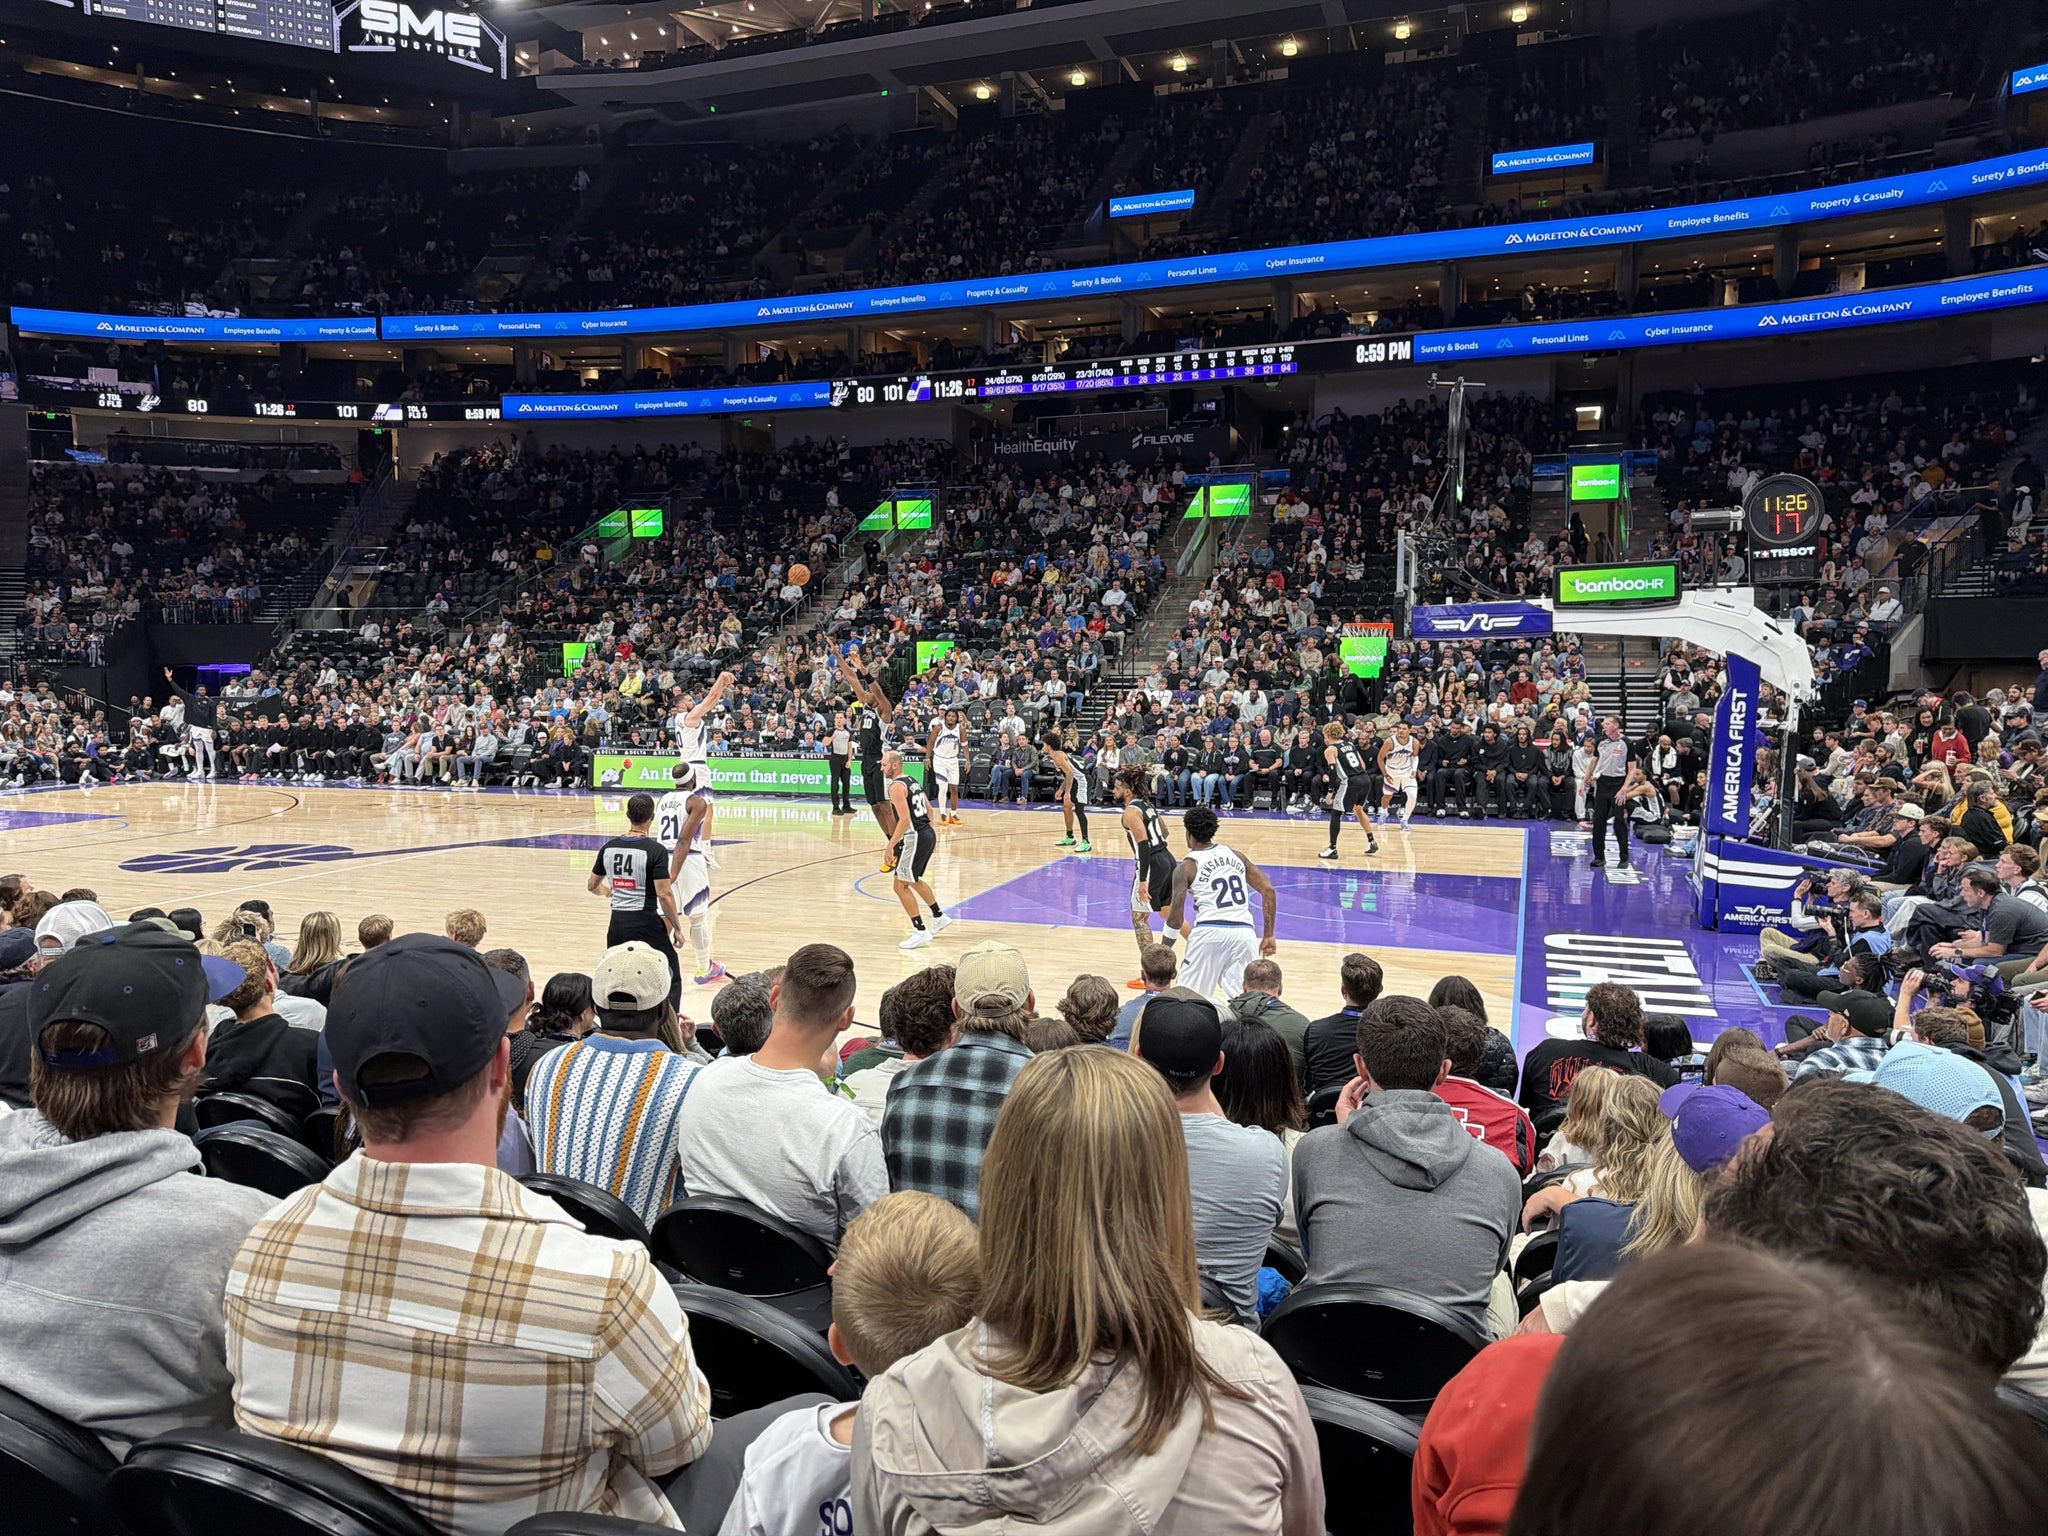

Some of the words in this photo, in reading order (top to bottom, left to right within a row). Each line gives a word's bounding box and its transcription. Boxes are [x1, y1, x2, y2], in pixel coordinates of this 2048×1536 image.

[361, 0, 480, 48] SME
[366, 34, 476, 58] INDUSTRIES
[1972, 172, 2004, 184] Surety
[2006, 168, 2014, 176] &
[2017, 160, 2048, 174] Bonds
[1811, 197, 1850, 210] Property
[1853, 196, 1860, 204] &
[1862, 188, 1904, 202] Casualty
[1668, 217, 1712, 228] Employee
[1714, 212, 1750, 222] Benefits
[1266, 259, 1286, 268] Cyber
[1288, 255, 1324, 266] Insurance
[1168, 267, 1197, 277] Personal
[1198, 266, 1217, 274] Lines
[1072, 278, 1093, 288] Surety
[1101, 276, 1122, 284] Bonds
[966, 288, 994, 298] Property
[1001, 284, 1028, 294] Casualty
[1941, 291, 1990, 305] Employee
[1992, 284, 2033, 297] Benefits
[870, 298, 900, 307] Employee
[224, 327, 255, 335] Employee
[351, 326, 376, 334] Casualty
[498, 322, 524, 330] Personal
[600, 320, 628, 328] Insurance
[1645, 328, 1669, 337] Cyber
[1672, 324, 1713, 334] Insurance
[1532, 334, 1565, 345] Personal
[1568, 334, 1589, 342] Lines
[1356, 343, 1385, 363] 8:59
[1389, 341, 1410, 360] PM
[1421, 345, 1445, 354] Surety
[1454, 342, 1478, 350] Bonds
[1076, 370, 1094, 379] 23/31
[1124, 367, 1129, 375] 11
[1174, 363, 1181, 371] 15
[1210, 360, 1216, 368] 3
[1246, 357, 1253, 365] 18
[1263, 355, 1273, 364] 93
[1281, 354, 1292, 362] 119
[1124, 377, 1129, 385] 6
[1139, 376, 1148, 384] 28
[1156, 374, 1165, 382] 34
[1173, 373, 1182, 381] 23
[1192, 372, 1199, 380] 15
[1210, 370, 1215, 378] 3
[1226, 368, 1234, 377] 14
[1245, 367, 1254, 375] 39
[1262, 365, 1273, 374] 121
[1281, 364, 1291, 372] 94
[857, 386, 874, 402] 80
[883, 385, 903, 401] 101
[934, 380, 962, 398] 11:26
[965, 388, 976, 396] 4TH
[188, 400, 208, 412] 80
[635, 402, 663, 410] Employee
[664, 400, 688, 408] Benefits
[724, 397, 746, 406] Property
[754, 395, 777, 403] Casualty
[254, 403, 284, 416] 11:26
[337, 406, 357, 417] 101
[466, 408, 484, 419] 8:59
[486, 408, 499, 419] PM
[994, 438, 1077, 454] HealthEquity
[1144, 434, 1194, 445] FILEVINE
[1765, 494, 1808, 512] 11:26
[1776, 512, 1800, 535] 17
[1770, 547, 1815, 557] TISSOT
[1575, 577, 1664, 593] bambooHR
[1728, 688, 1747, 740] FIRST
[862, 719, 872, 728] 10
[1346, 752, 1360, 768] 8
[639, 768, 659, 780] An
[750, 770, 778, 783] that
[780, 773, 823, 785] never
[1722, 743, 1743, 823] AMERICA
[661, 815, 678, 841] 21
[614, 854, 633, 876] 24
[1199, 856, 1245, 882] SENSABAUGH
[1211, 875, 1246, 909] 28
[1724, 913, 1765, 922] AMERICA
[1766, 916, 1792, 924] FIRST
